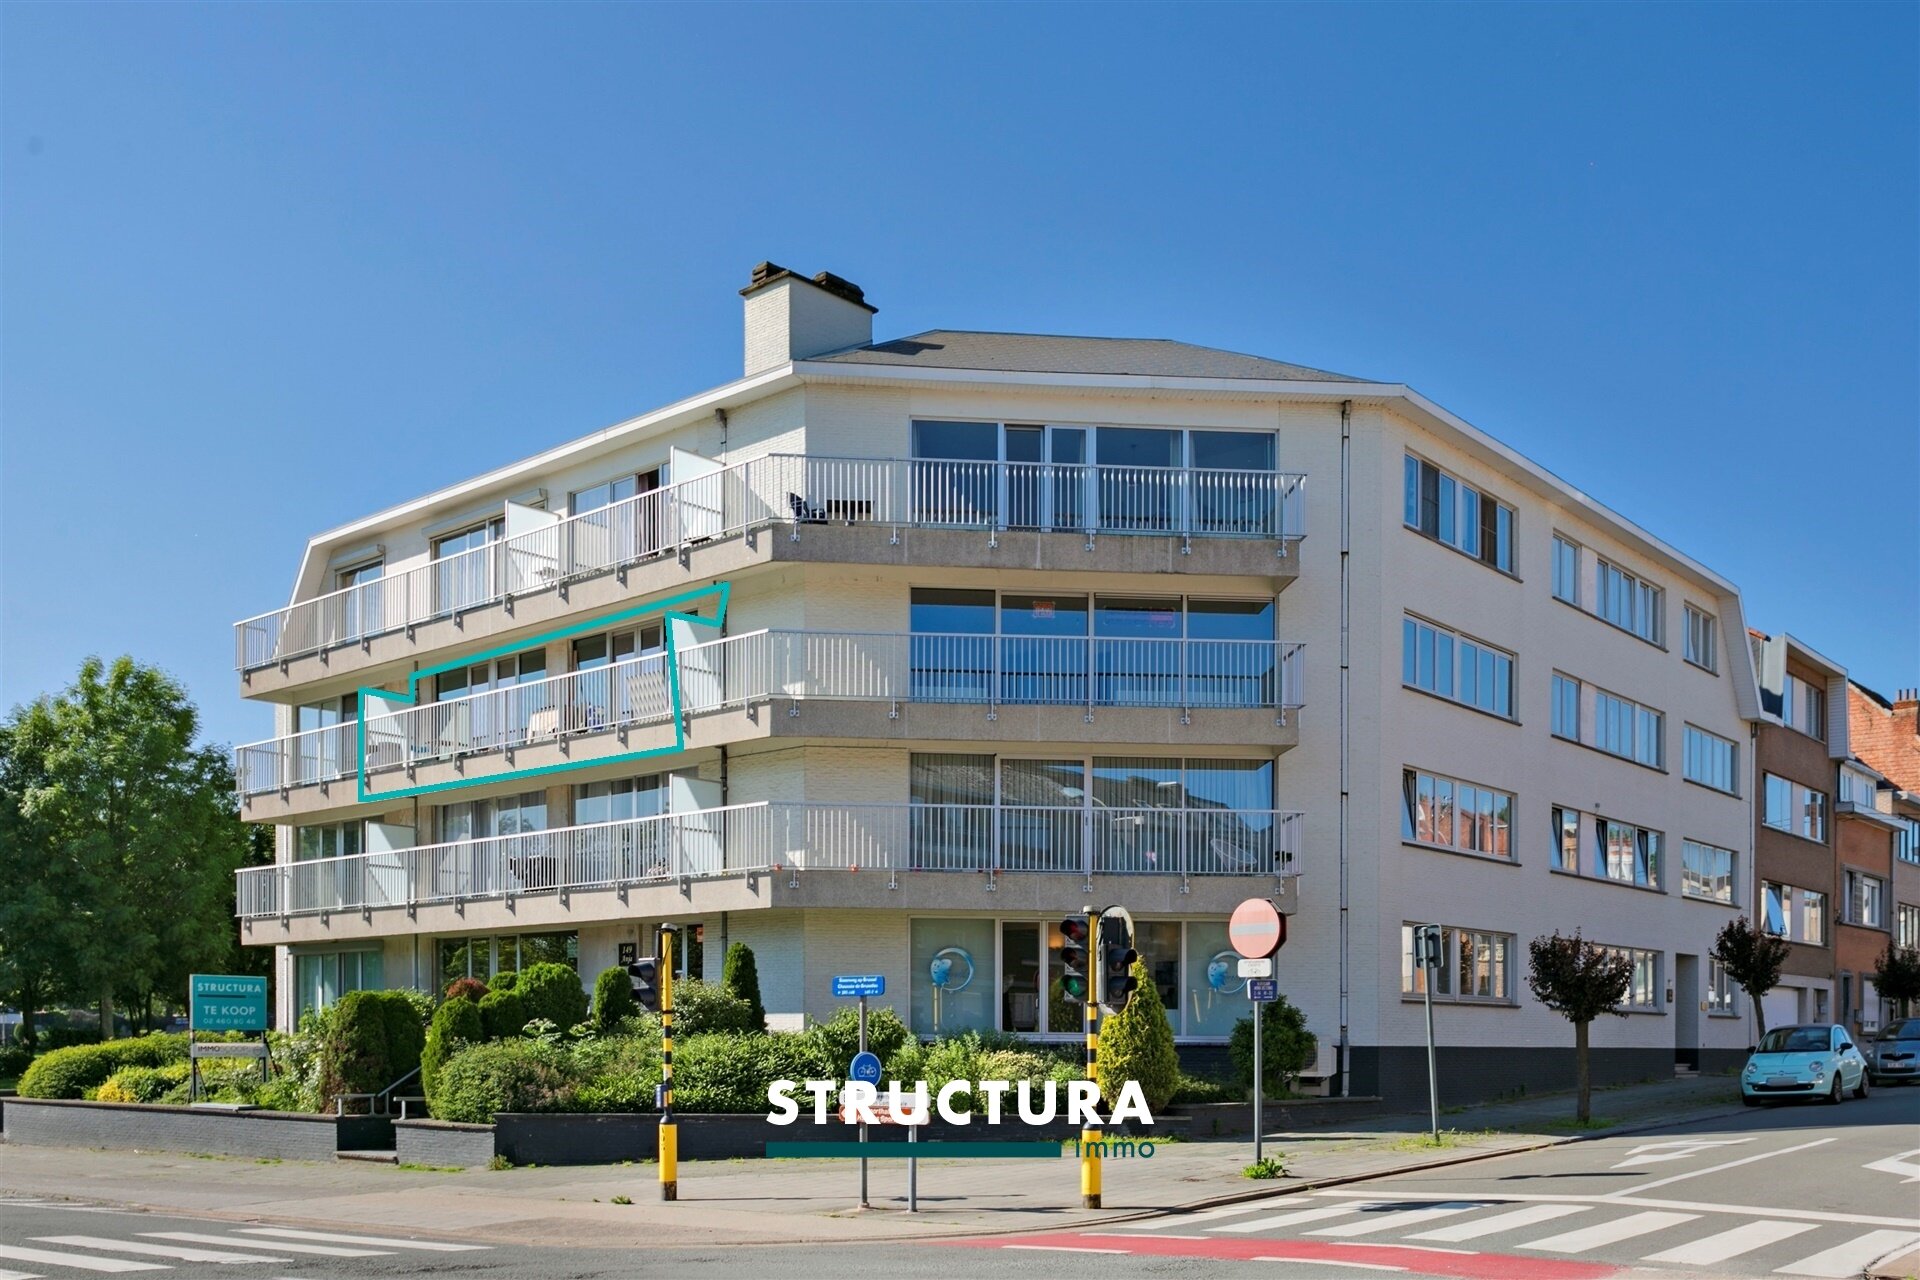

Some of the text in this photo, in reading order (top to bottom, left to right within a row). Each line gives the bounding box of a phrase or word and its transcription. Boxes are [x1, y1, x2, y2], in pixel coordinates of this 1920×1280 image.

[198, 982, 262, 992] STRUCTURA
[204, 1006, 256, 1015] TE KOOP
